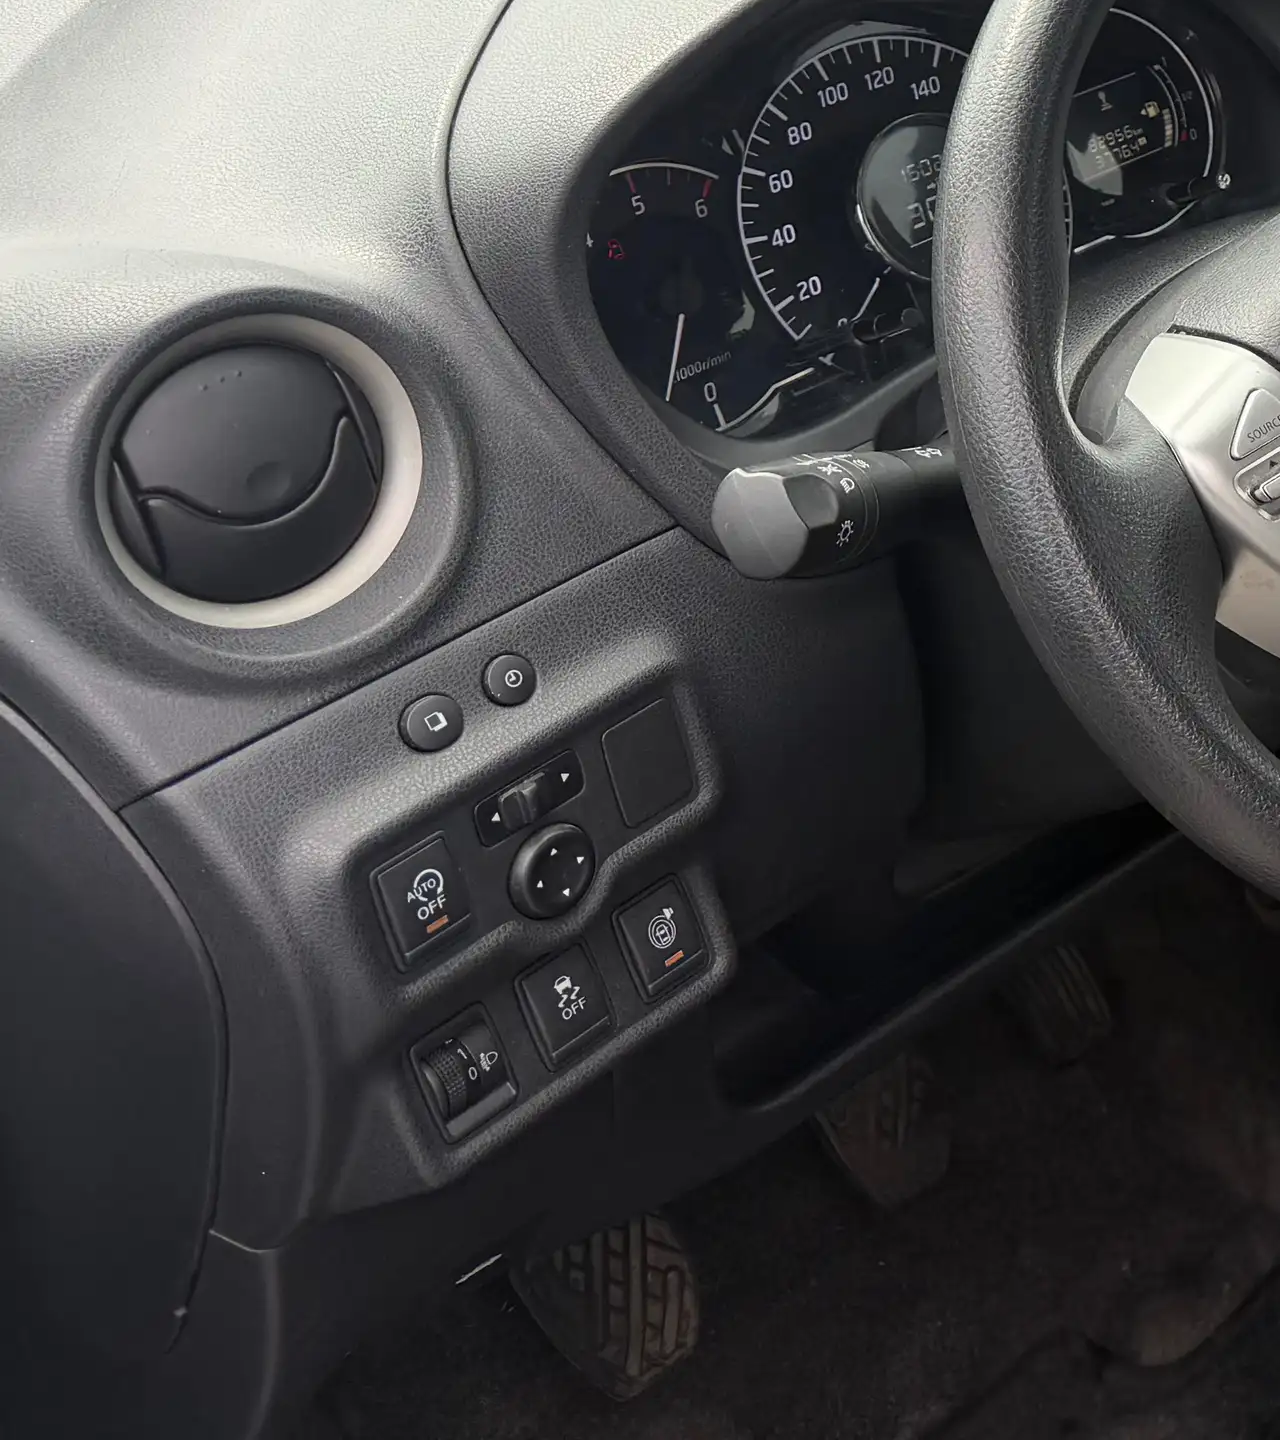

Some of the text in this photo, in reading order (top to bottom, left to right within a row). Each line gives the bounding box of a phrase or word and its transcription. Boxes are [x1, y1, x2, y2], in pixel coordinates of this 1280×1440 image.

[864, 66, 895, 91] 120
[910, 75, 941, 100] 140
[817, 82, 849, 108] 100
[787, 121, 813, 146] 80
[768, 168, 794, 194] 60
[631, 195, 646, 216] 5
[694, 198, 708, 218] 6
[771, 223, 796, 248] 40
[796, 275, 822, 302] 20
[674, 349, 733, 383] 1000r/min
[703, 381, 717, 402] 0
[407, 877, 437, 903] AUTO
[417, 894, 447, 920] OFF
[562, 996, 587, 1020] OFF
[456, 1047, 468, 1060] 1
[468, 1066, 478, 1080] 0
